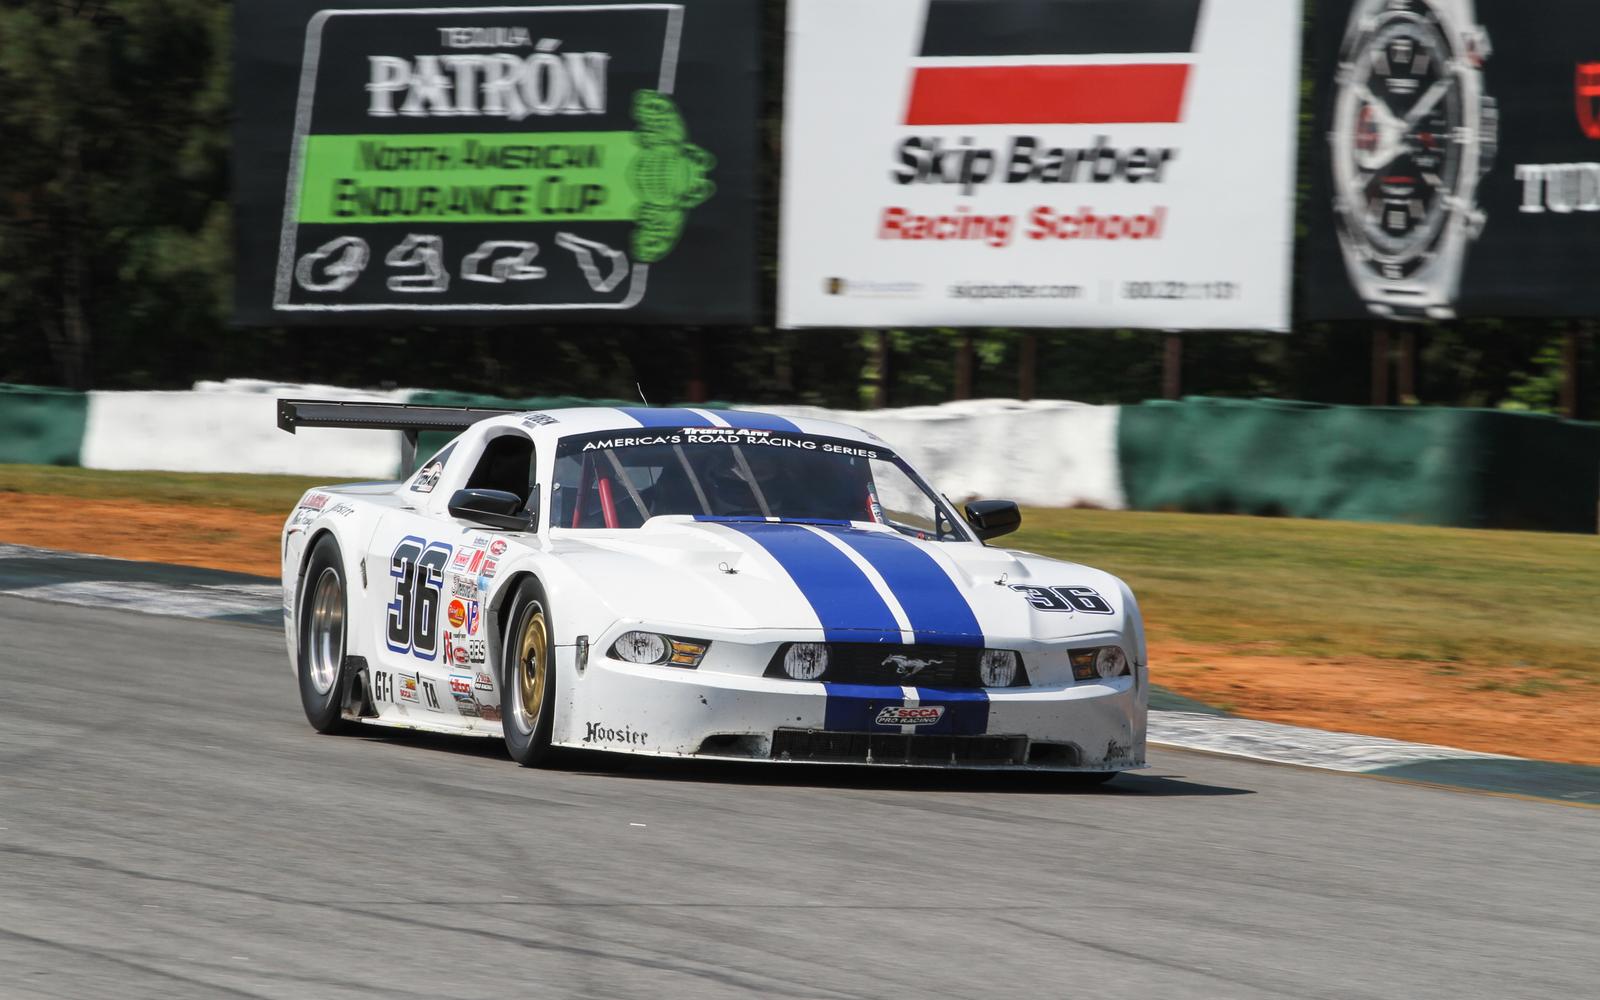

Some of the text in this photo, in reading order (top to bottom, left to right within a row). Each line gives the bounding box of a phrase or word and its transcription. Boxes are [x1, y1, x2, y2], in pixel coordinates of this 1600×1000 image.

[366, 38, 611, 120] PATRÓN
[890, 135, 1179, 196] Skip Barber
[878, 205, 1167, 247] Racing School
[582, 434, 878, 459] AMERICA'S ROAD RACING SERIES
[682, 427, 772, 437] Trans Am
[386, 535, 453, 661] 36
[1008, 584, 1115, 615] 36
[375, 670, 394, 703] GT-1
[422, 681, 441, 709] TA
[898, 709, 939, 717] SCCA
[582, 721, 649, 745] Hoosier
